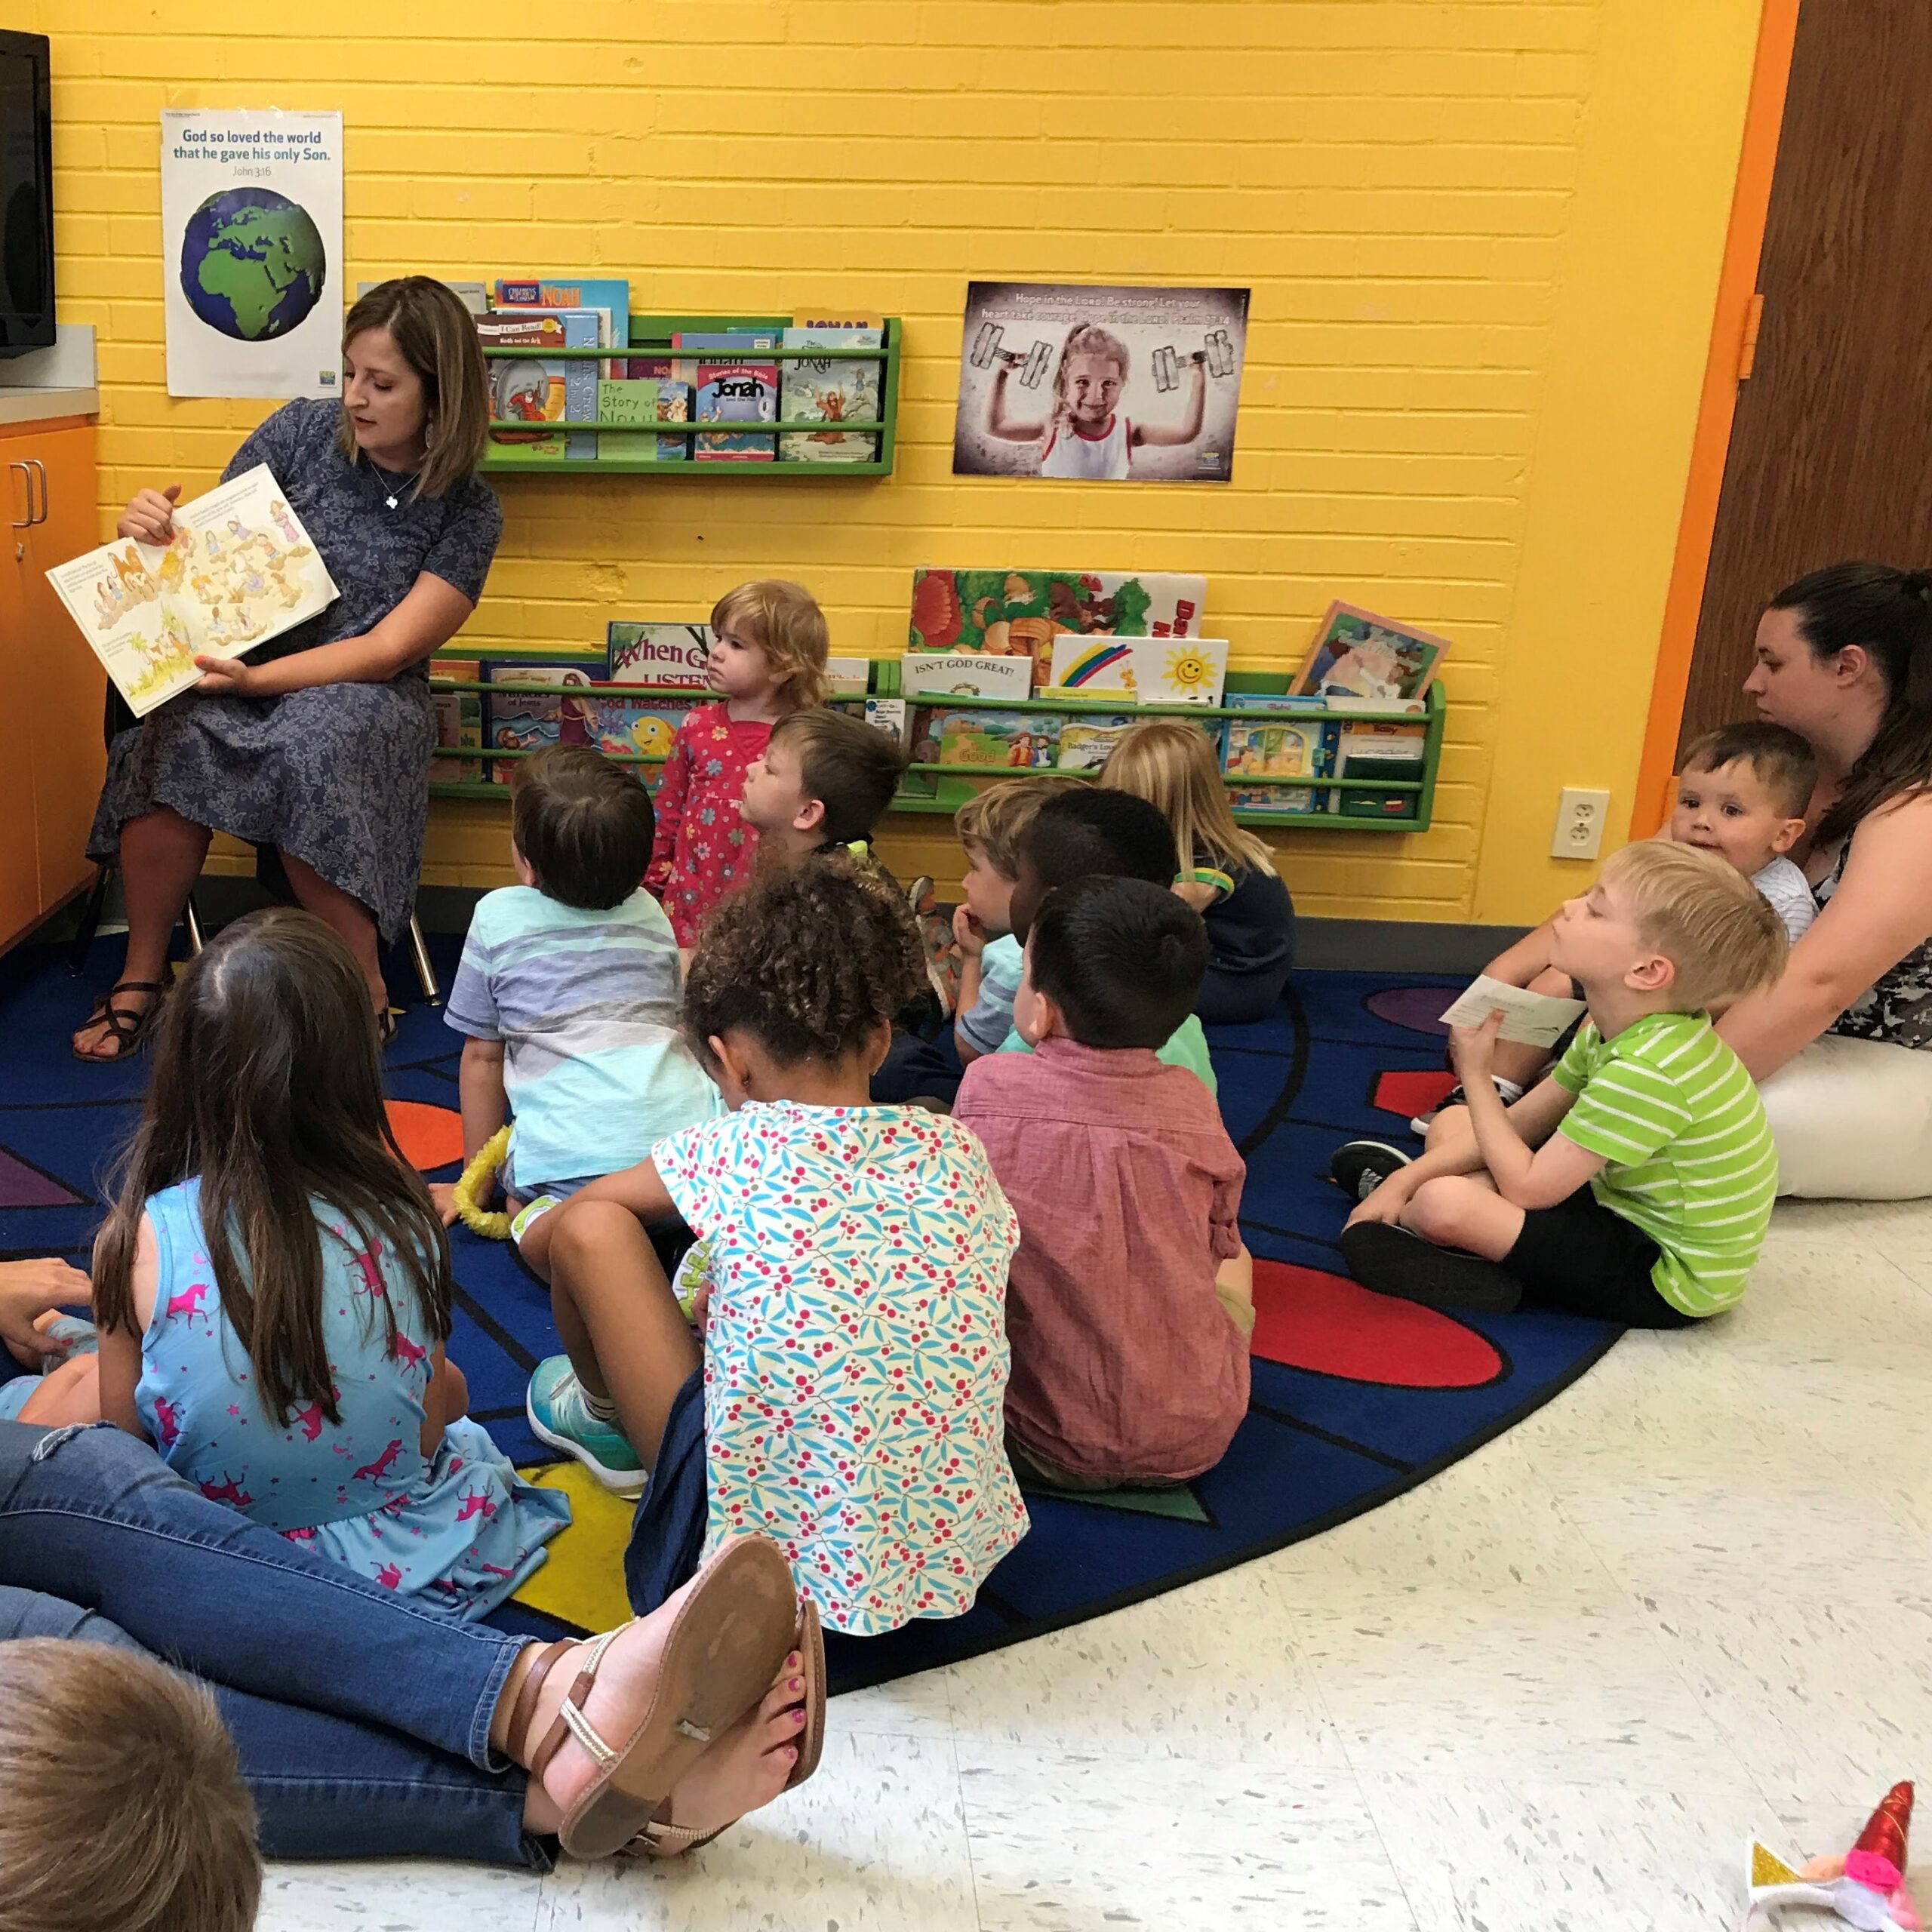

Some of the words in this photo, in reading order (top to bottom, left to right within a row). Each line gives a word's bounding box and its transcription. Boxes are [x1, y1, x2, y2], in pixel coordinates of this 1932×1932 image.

[183, 129, 207, 142] God
[210, 132, 224, 142] so
[227, 131, 260, 143] loved
[263, 131, 284, 143] the
[286, 131, 321, 143] world
[174, 146, 199, 159] that
[202, 146, 217, 159] he
[220, 150, 250, 163] gave
[252, 147, 271, 160] his
[273, 149, 300, 164] only
[303, 148, 331, 161] Son.
[232, 166, 253, 177] John
[255, 167, 272, 177] 3:16
[542, 285, 580, 306] NOAH
[1016, 293, 1041, 306] Hope
[1044, 295, 1054, 305] in
[1057, 295, 1073, 305] the
[1107, 297, 1118, 306] Be
[1122, 298, 1158, 310] strong!
[1159, 298, 1176, 308] Let
[1177, 300, 1201, 312] your
[981, 308, 1009, 318] heart
[1012, 310, 1033, 320] take
[506, 324, 520, 333] Can
[521, 322, 541, 332] Read!
[709, 369, 731, 380] Stories
[602, 384, 623, 394] The
[712, 377, 764, 398] Jonah
[602, 396, 639, 409] Story
[645, 398, 656, 408] of
[620, 638, 683, 669] When
[915, 661, 944, 674] ISN'T
[947, 660, 972, 668] GOD
[975, 660, 1014, 677] GREAT!
